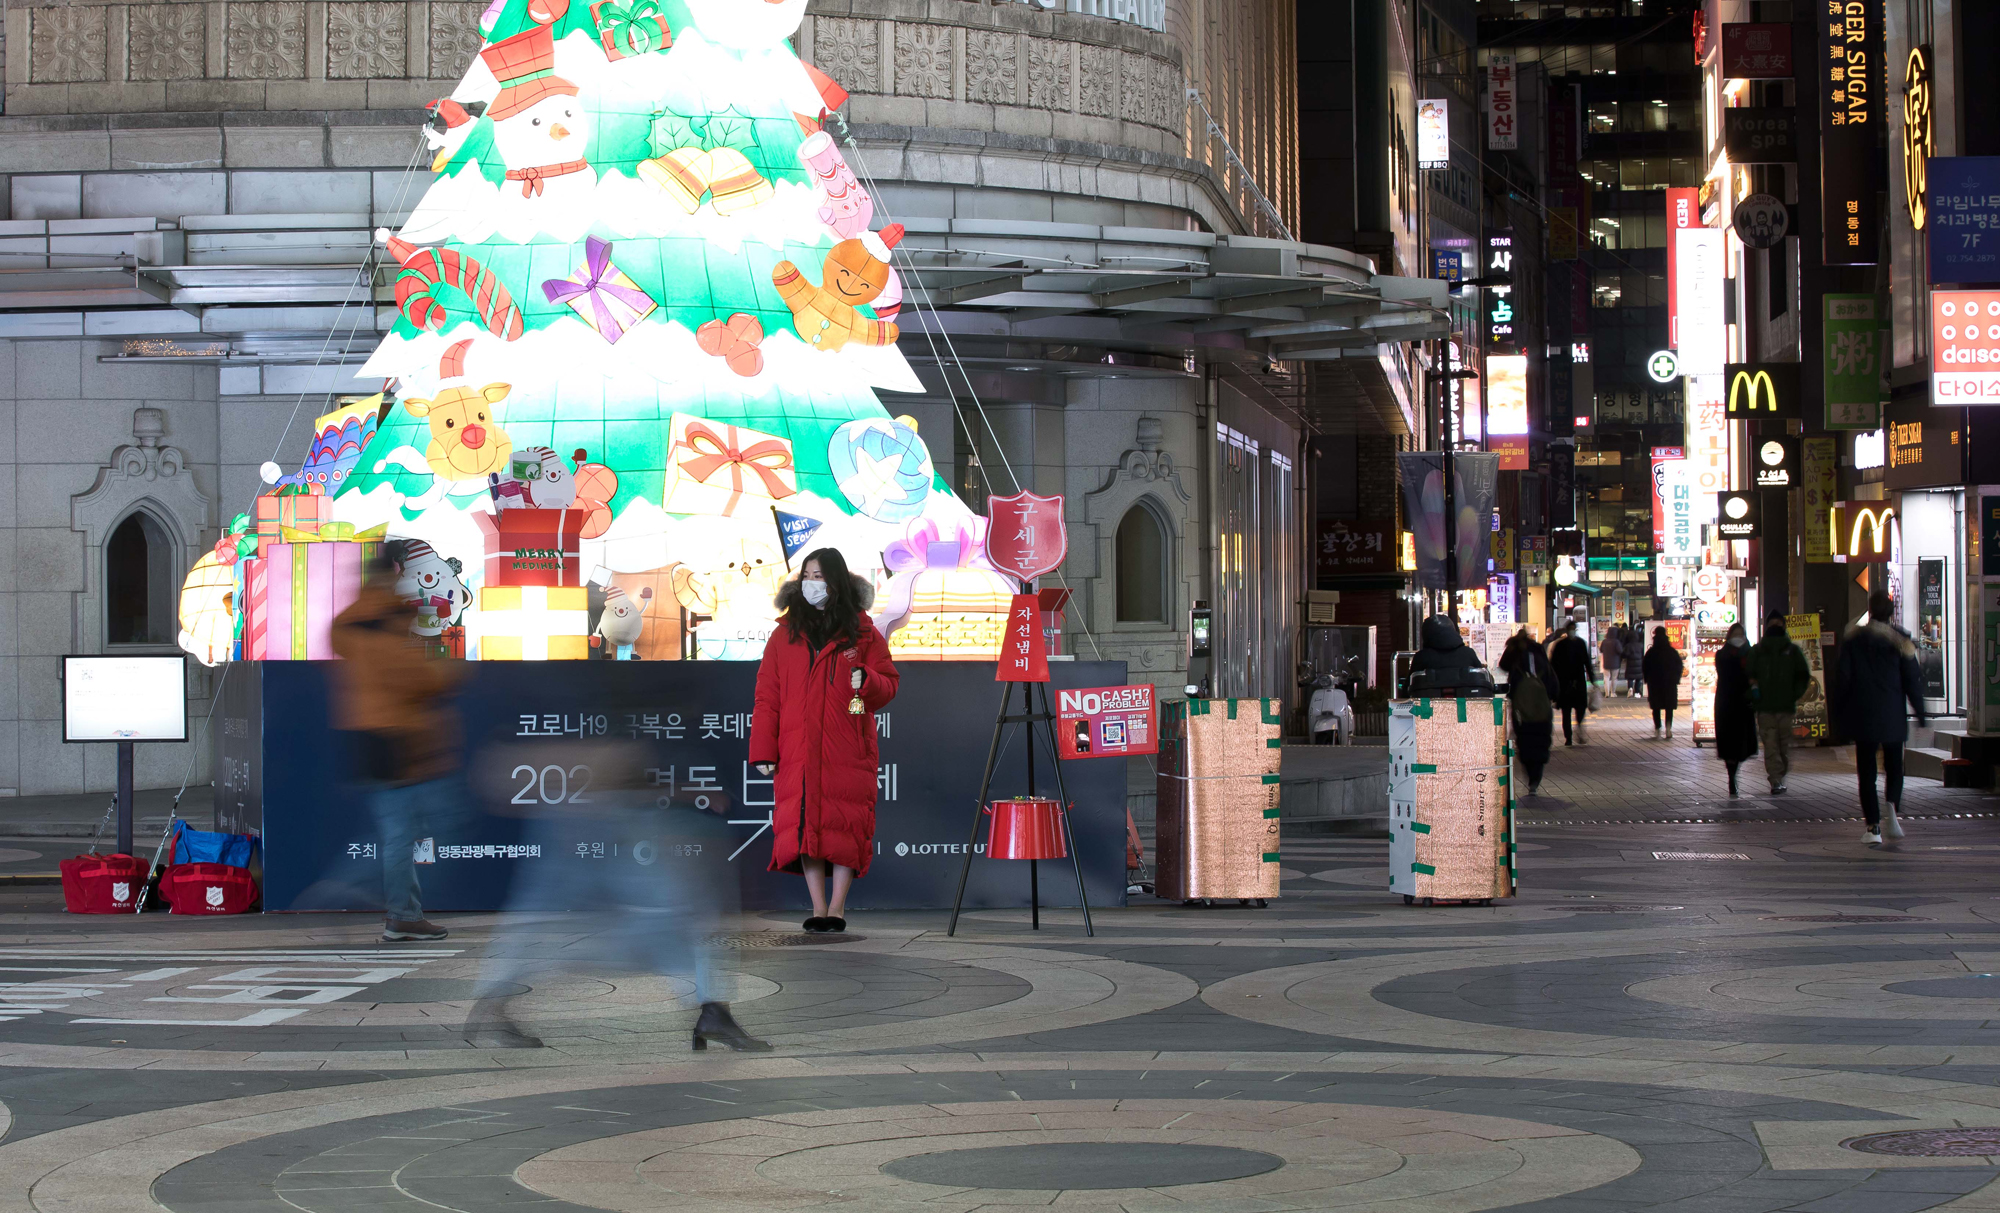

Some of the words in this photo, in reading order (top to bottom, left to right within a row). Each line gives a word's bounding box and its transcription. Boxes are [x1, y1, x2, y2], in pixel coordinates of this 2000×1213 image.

[1846, 0, 1865, 44] GER
[1728, 28, 1741, 38] 4F
[1847, 50, 1867, 125] SUGAR
[1492, 66, 1513, 136] 부동산
[1732, 117, 1788, 131] Korea
[1752, 134, 1787, 149] Spa
[1419, 161, 1432, 169] EEF
[1433, 161, 1448, 169] BBQ
[1936, 196, 2000, 211] 라임나무
[1676, 198, 1689, 228] RED
[1936, 214, 2000, 229] 치과병원
[1846, 200, 1860, 246] 명동점
[1490, 238, 1511, 247] STAR
[1961, 233, 1982, 248] 7F
[1438, 257, 1458, 268] 번역
[1835, 304, 1868, 315] おかゆ
[1492, 325, 1513, 334] Cafe
[1830, 331, 1875, 376] 粥
[1942, 344, 2000, 363] daiso
[1938, 380, 2000, 396] 다이소
[1908, 421, 1923, 445] SUGAR
[1808, 475, 1818, 483] IN
[783, 518, 810, 533] VISIT
[1674, 485, 1690, 551] 대한곱창
[786, 529, 815, 547] SEOUL
[1013, 502, 1039, 570] 구세군
[514, 547, 565, 560] MERRY
[512, 561, 568, 571] MEDIHEAL
[1697, 572, 1723, 597] 약
[1615, 600, 1625, 621] 활어
[1785, 614, 1813, 623] MONEY
[1014, 606, 1033, 672] 자선냄비
[1060, 690, 1102, 715] NO
[1101, 688, 1150, 702] CASH?
[1102, 699, 1150, 710] PROBLEM
[516, 713, 608, 739] 코로나19
[624, 713, 686, 740] 극복은
[699, 713, 753, 739] 롯데
[1811, 723, 1827, 737] 5F
[645, 764, 723, 810] 명동
[1475, 772, 1487, 822] Smart-Q
[346, 843, 377, 860] 주최
[438, 845, 541, 858] 명동관광특구협의회
[575, 842, 605, 859] 후원
[912, 843, 960, 854] LOTTE
